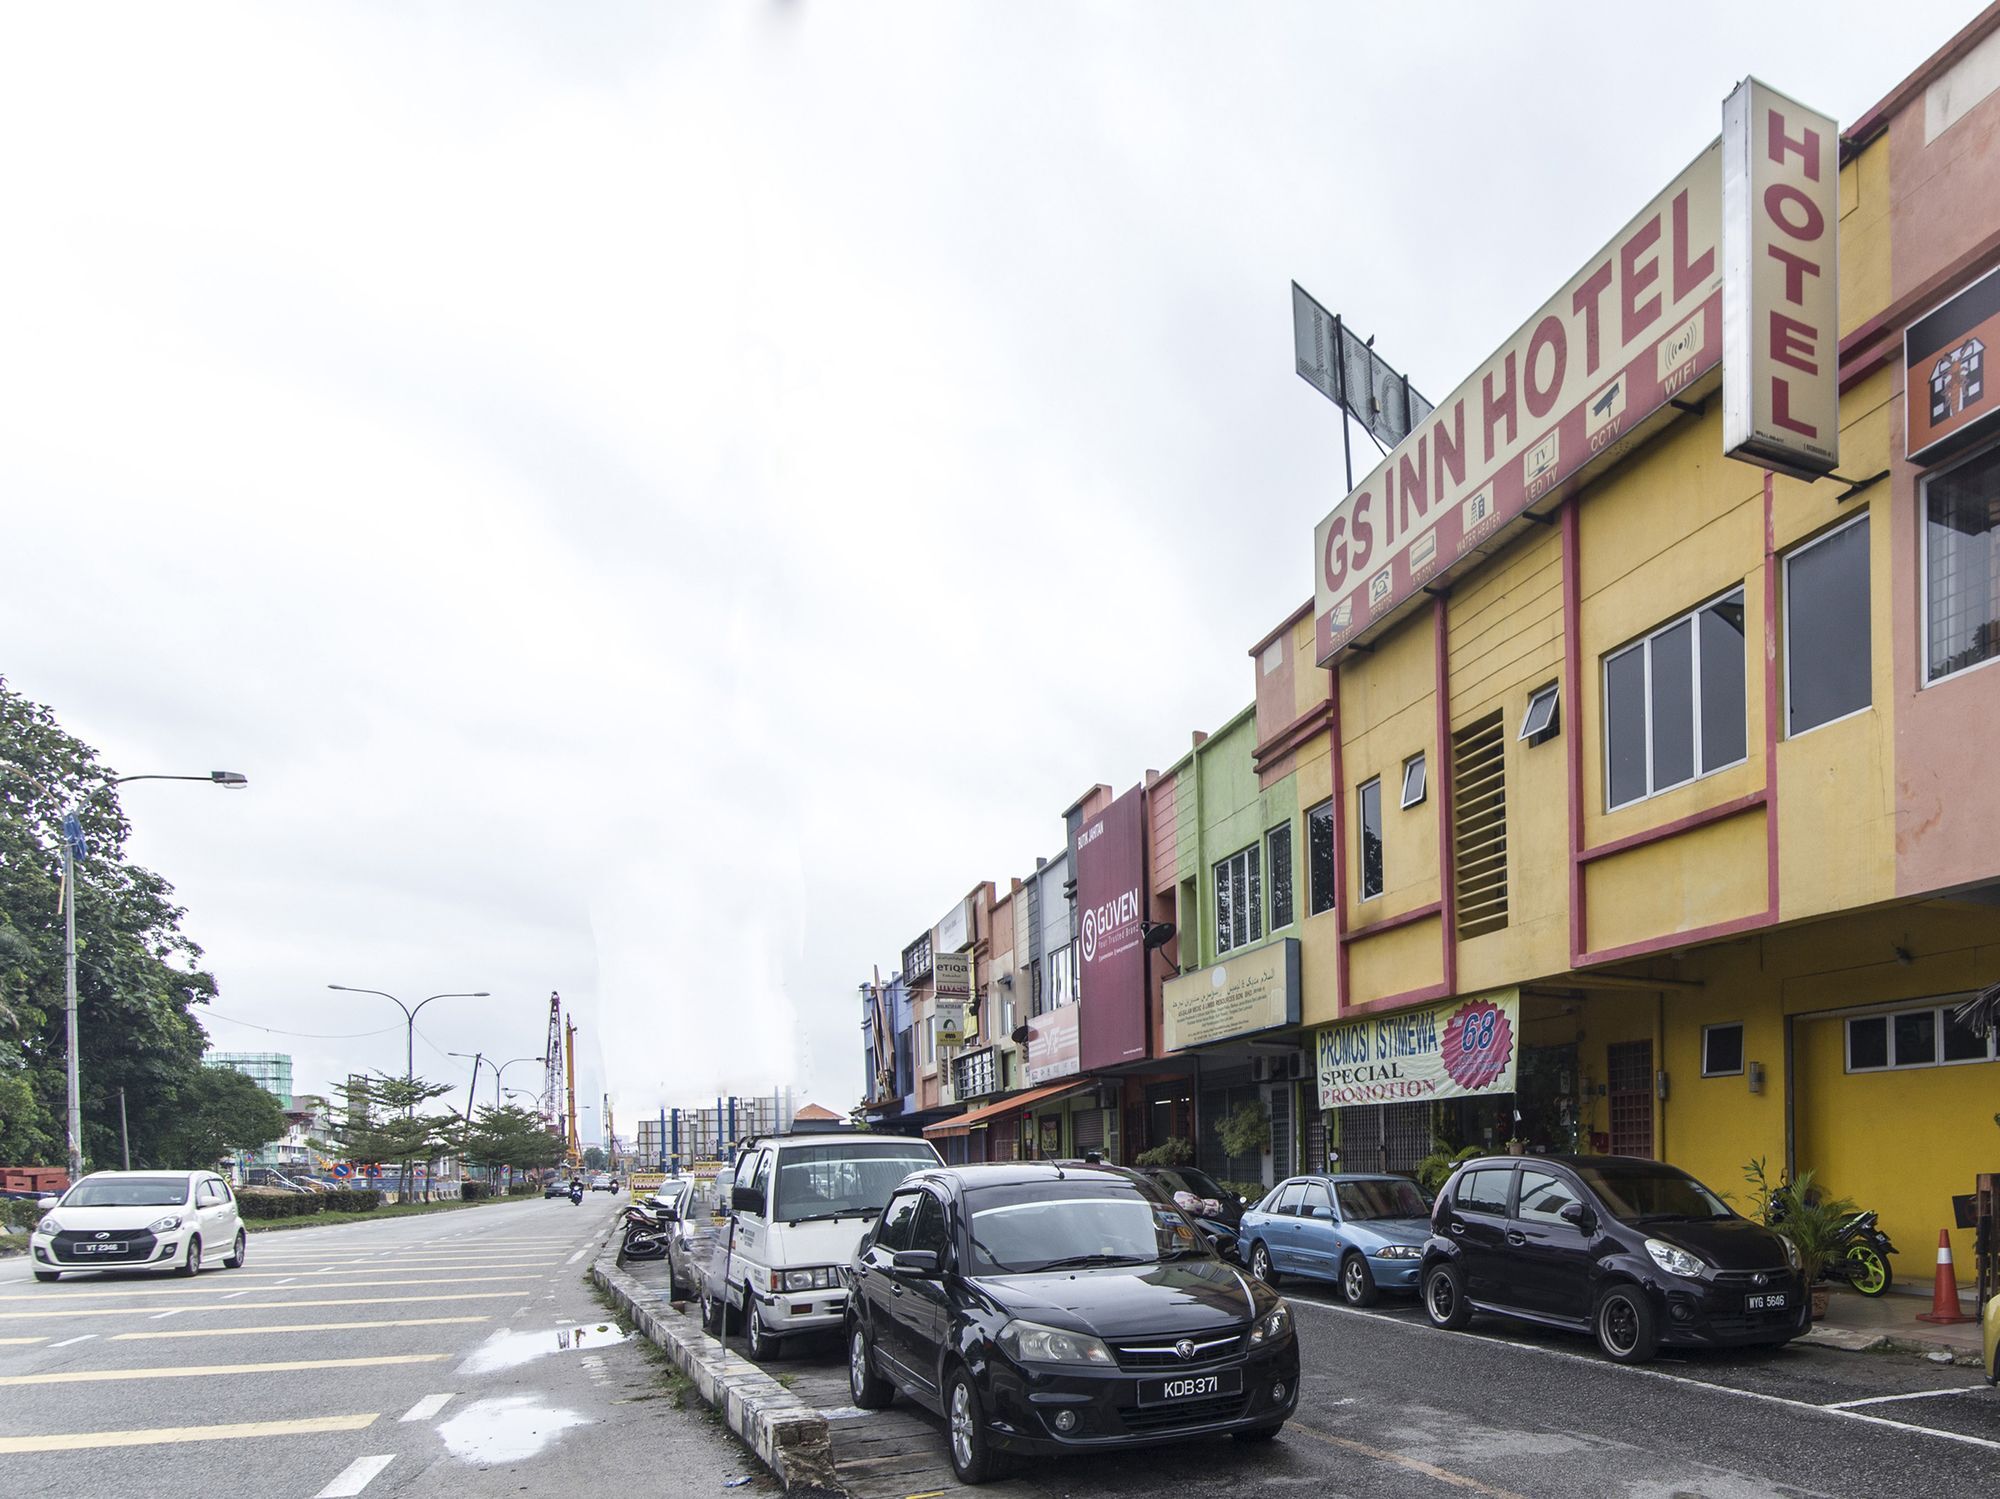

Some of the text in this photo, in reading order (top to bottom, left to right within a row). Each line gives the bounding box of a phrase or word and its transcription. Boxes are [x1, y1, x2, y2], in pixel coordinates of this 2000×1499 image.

[1764, 108, 1825, 439] HOTEL
[1324, 187, 1715, 593] GS INN HOTEL
[1664, 358, 1697, 395] WIFI
[1590, 416, 1622, 452] CCTV
[1525, 465, 1558, 502] LED TV
[1097, 887, 1138, 935] GÜVEN
[1320, 1010, 1438, 1069] PROMOSI ISTIMEWA
[1461, 1009, 1496, 1053] 68
[1321, 1062, 1405, 1087] SPECIAL
[1321, 1078, 1437, 1106] PROMOTION
[1749, 1294, 1785, 1308] WYG 5646
[1164, 1376, 1218, 1398] KDB371
